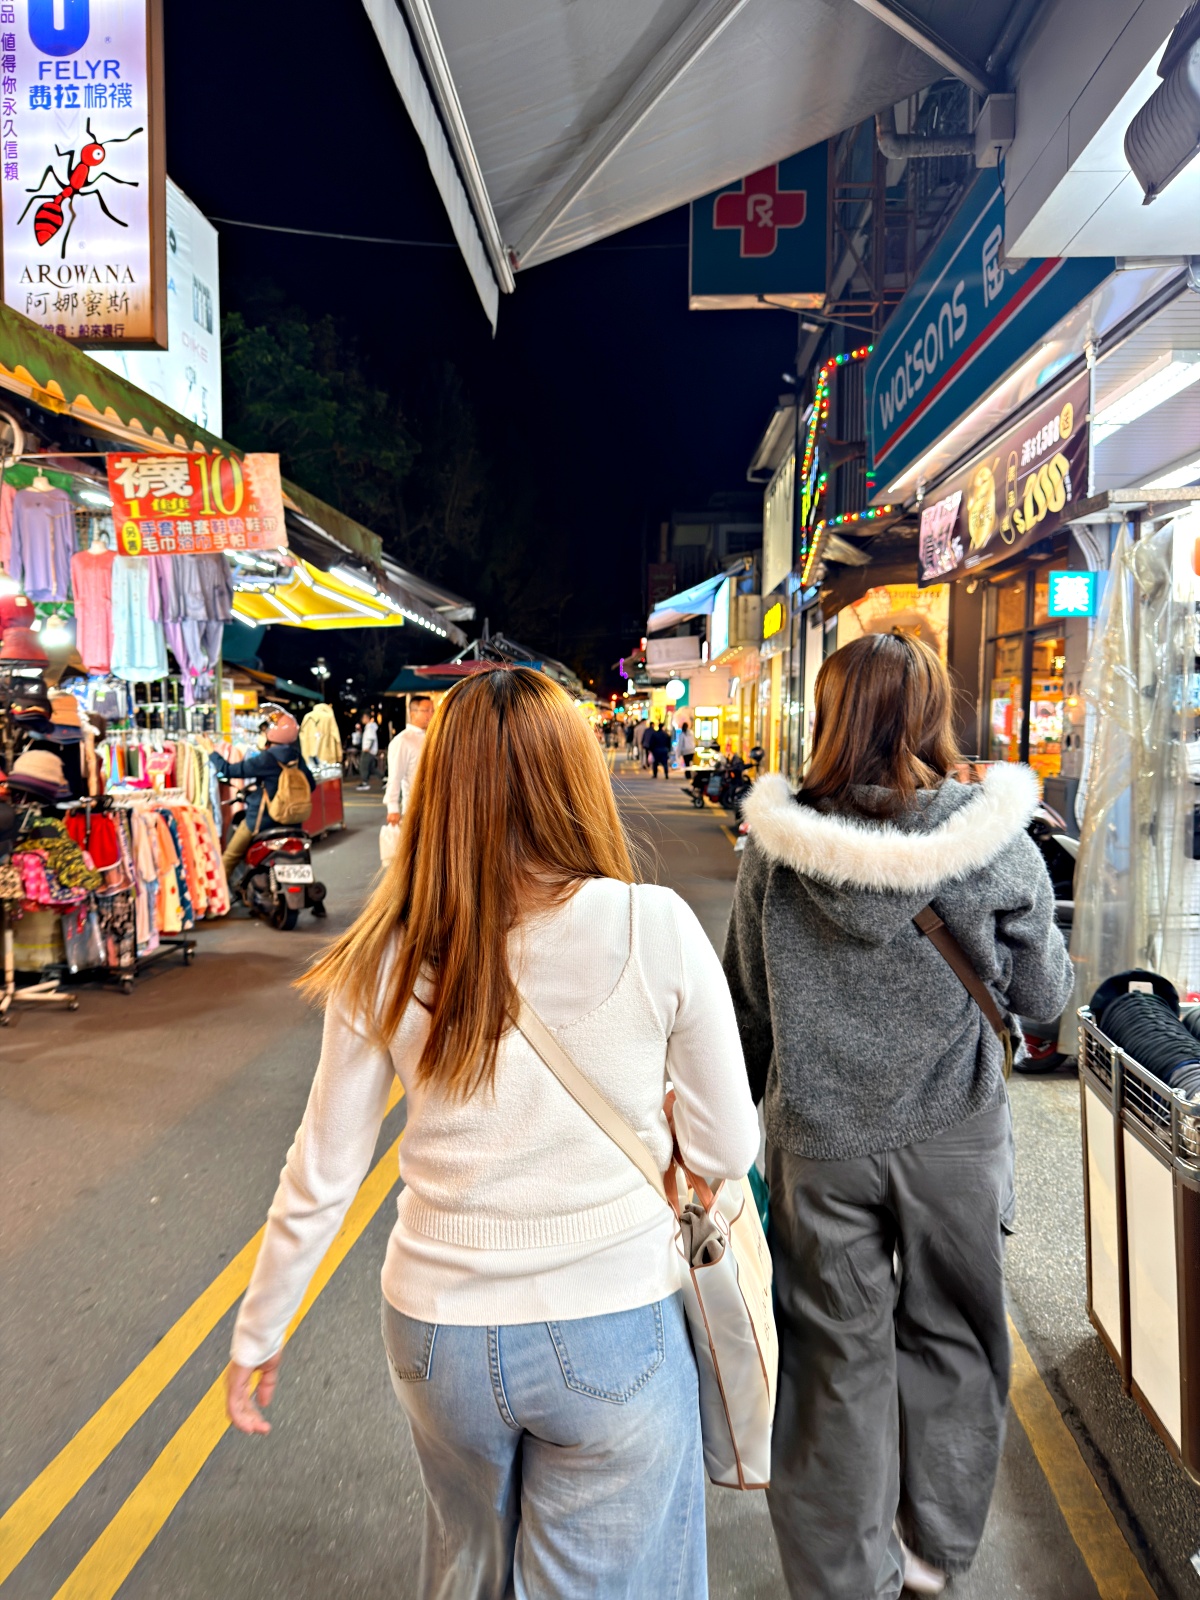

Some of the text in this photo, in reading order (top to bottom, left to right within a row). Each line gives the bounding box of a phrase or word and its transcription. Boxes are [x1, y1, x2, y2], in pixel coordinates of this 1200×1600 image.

[38, 59, 121, 80] FELYR
[1, 32, 19, 181] 值得你永久信賴
[29, 83, 133, 110] 費拉棉襪
[19, 264, 136, 289] AROWANA
[26, 289, 130, 317] 阿娜蜜斯
[880, 280, 967, 430] watsons
[114, 456, 194, 499] 襪
[195, 454, 244, 515] 10
[1053, 575, 1090, 612] 藥
